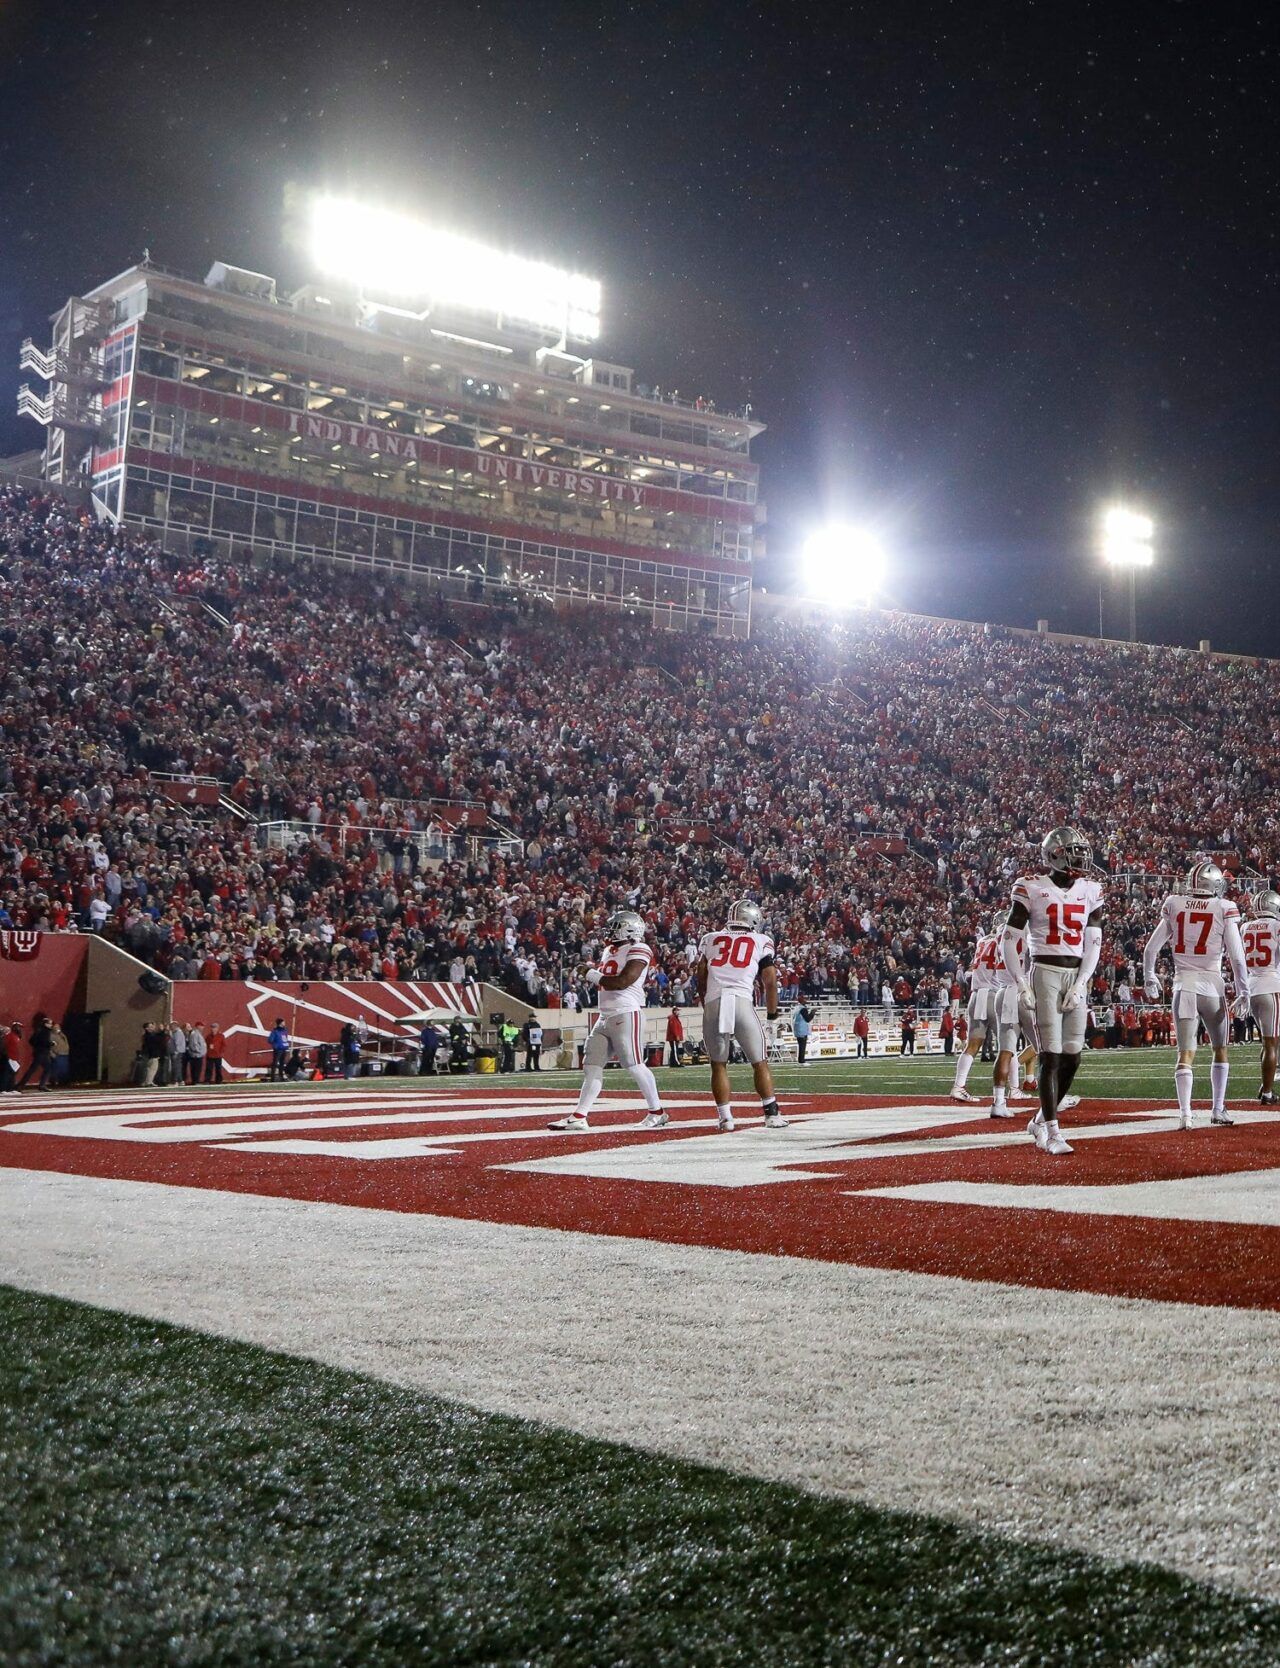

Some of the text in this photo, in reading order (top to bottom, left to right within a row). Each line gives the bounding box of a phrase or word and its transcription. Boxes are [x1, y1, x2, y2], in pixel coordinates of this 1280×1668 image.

[289, 414, 645, 503] INDIANA UNIVERSITY
[188, 788, 197, 799] 4
[461, 811, 470, 821] 5
[689, 829, 696, 839] 6
[885, 842, 892, 851] 7
[1184, 900, 1209, 910] SHAW
[1045, 903, 1085, 946] 15
[1174, 911, 1214, 955] 17
[710, 935, 756, 969] 30
[1243, 932, 1272, 968] 25
